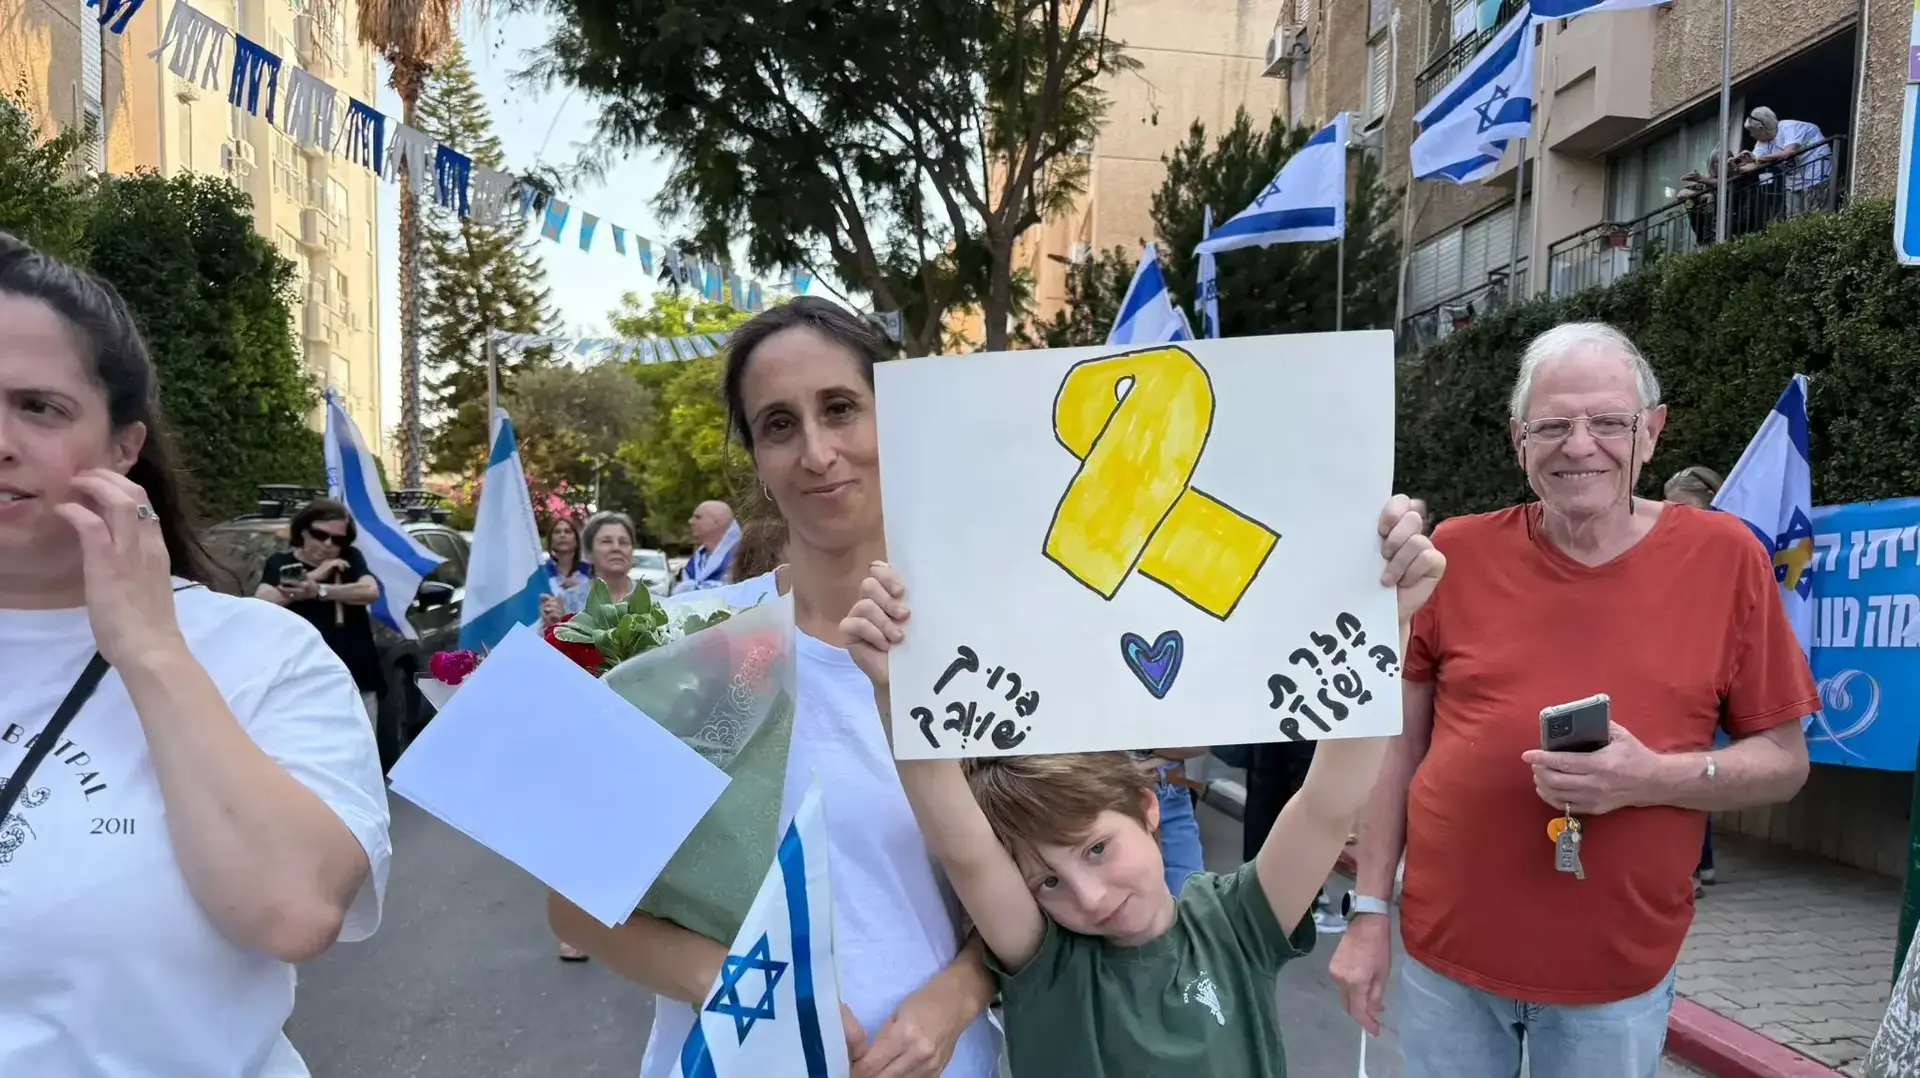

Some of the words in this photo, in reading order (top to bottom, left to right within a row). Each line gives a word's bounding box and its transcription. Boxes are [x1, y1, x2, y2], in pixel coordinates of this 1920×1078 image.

[1848, 526, 1920, 579] יתן
[933, 645, 1040, 718] ברוך
[89, 817, 136, 835] 2011
